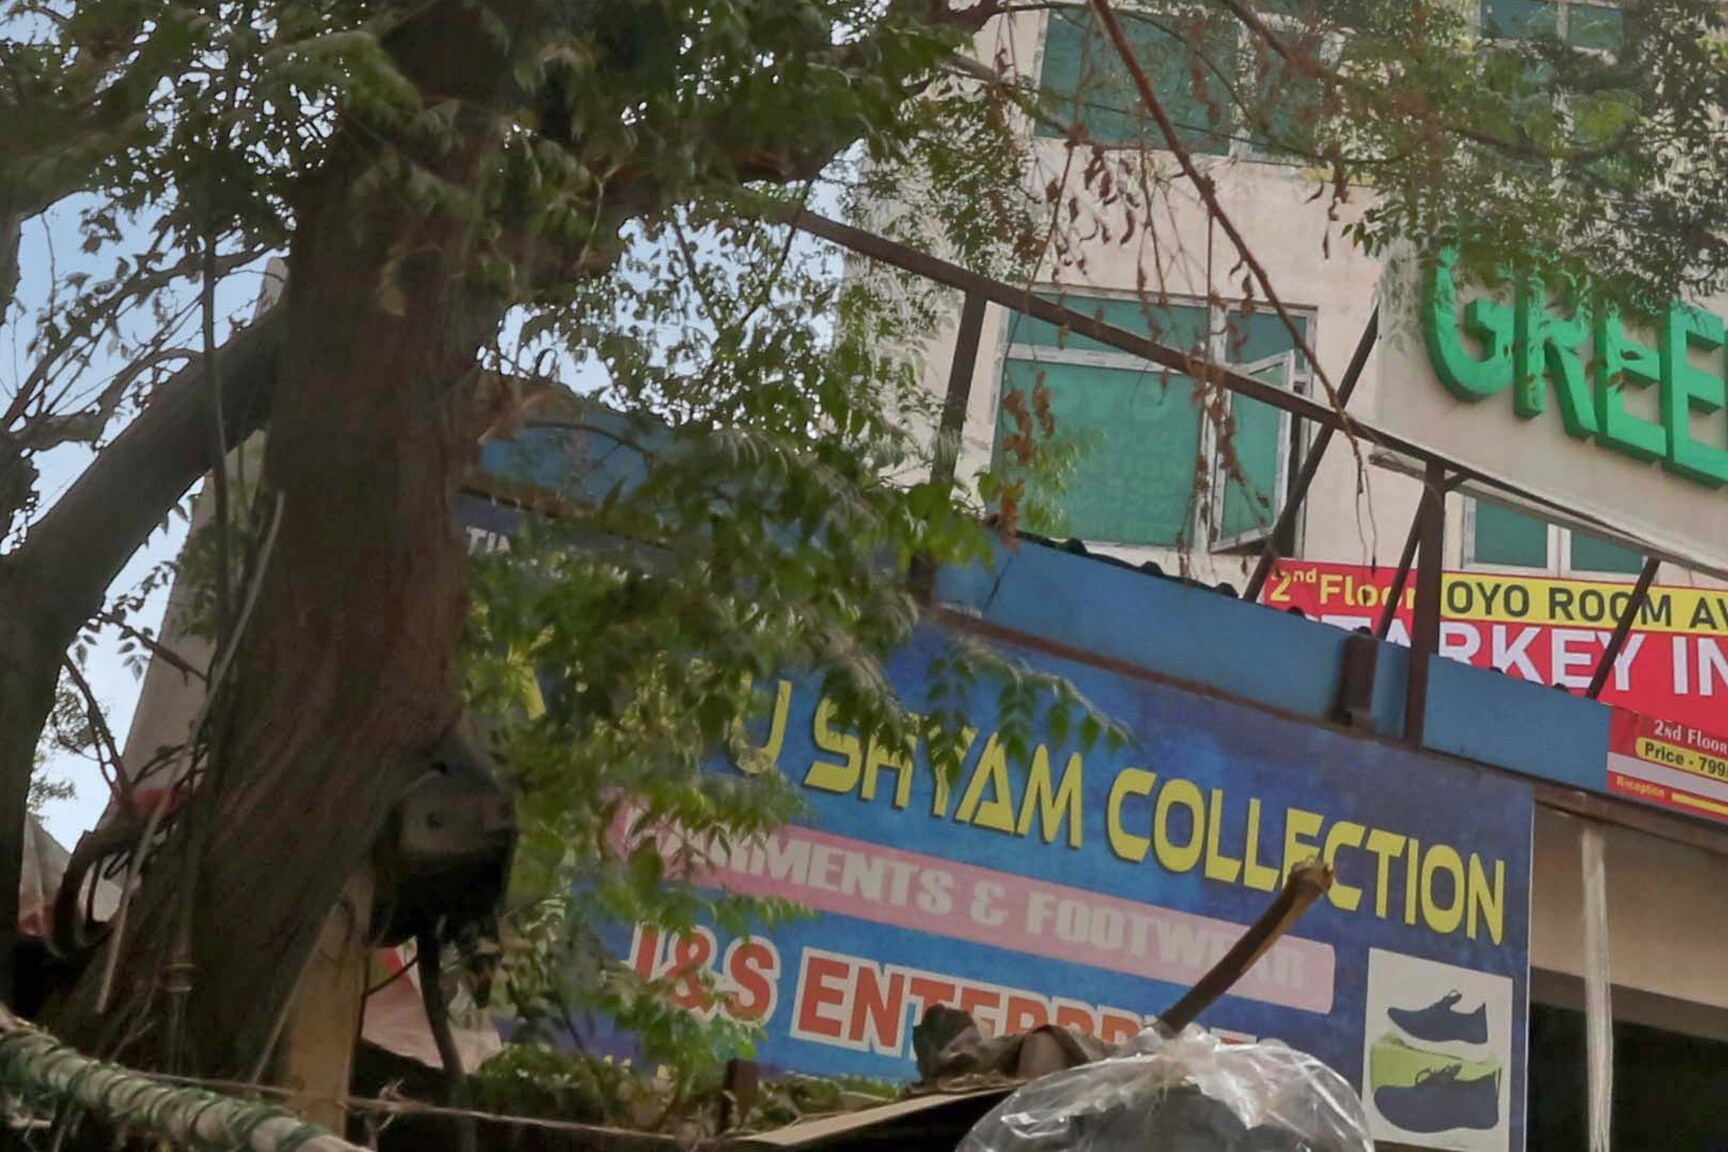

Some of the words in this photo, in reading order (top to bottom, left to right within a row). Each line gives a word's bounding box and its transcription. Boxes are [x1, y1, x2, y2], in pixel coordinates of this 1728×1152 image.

[1447, 580, 1530, 618] OYO
[1549, 586, 1673, 628] ROOM
[1304, 614, 1645, 693] RKEY
[1644, 741, 1685, 766] Price
[804, 697, 1082, 849] SHYAM
[1106, 766, 1505, 947] COLLECTION
[1026, 894, 1306, 991] FOOTWR
